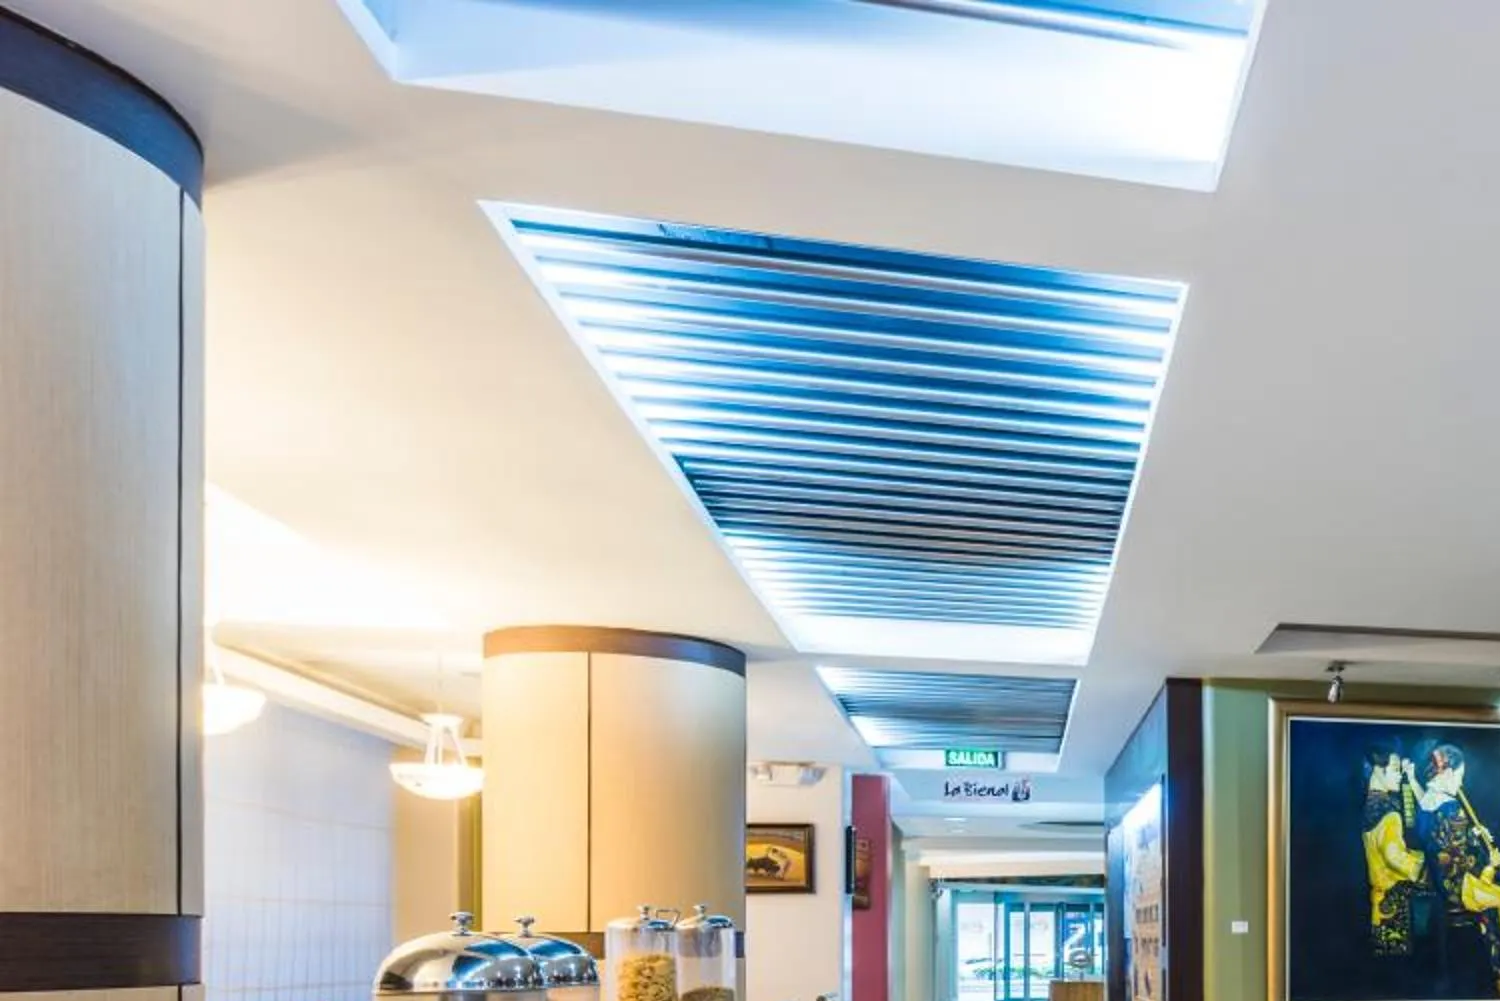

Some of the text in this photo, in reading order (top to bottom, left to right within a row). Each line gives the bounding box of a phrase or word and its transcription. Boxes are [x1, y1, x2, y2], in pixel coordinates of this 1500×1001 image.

[948, 751, 995, 765] SALIDA
[944, 781, 1009, 797] La Bienal
